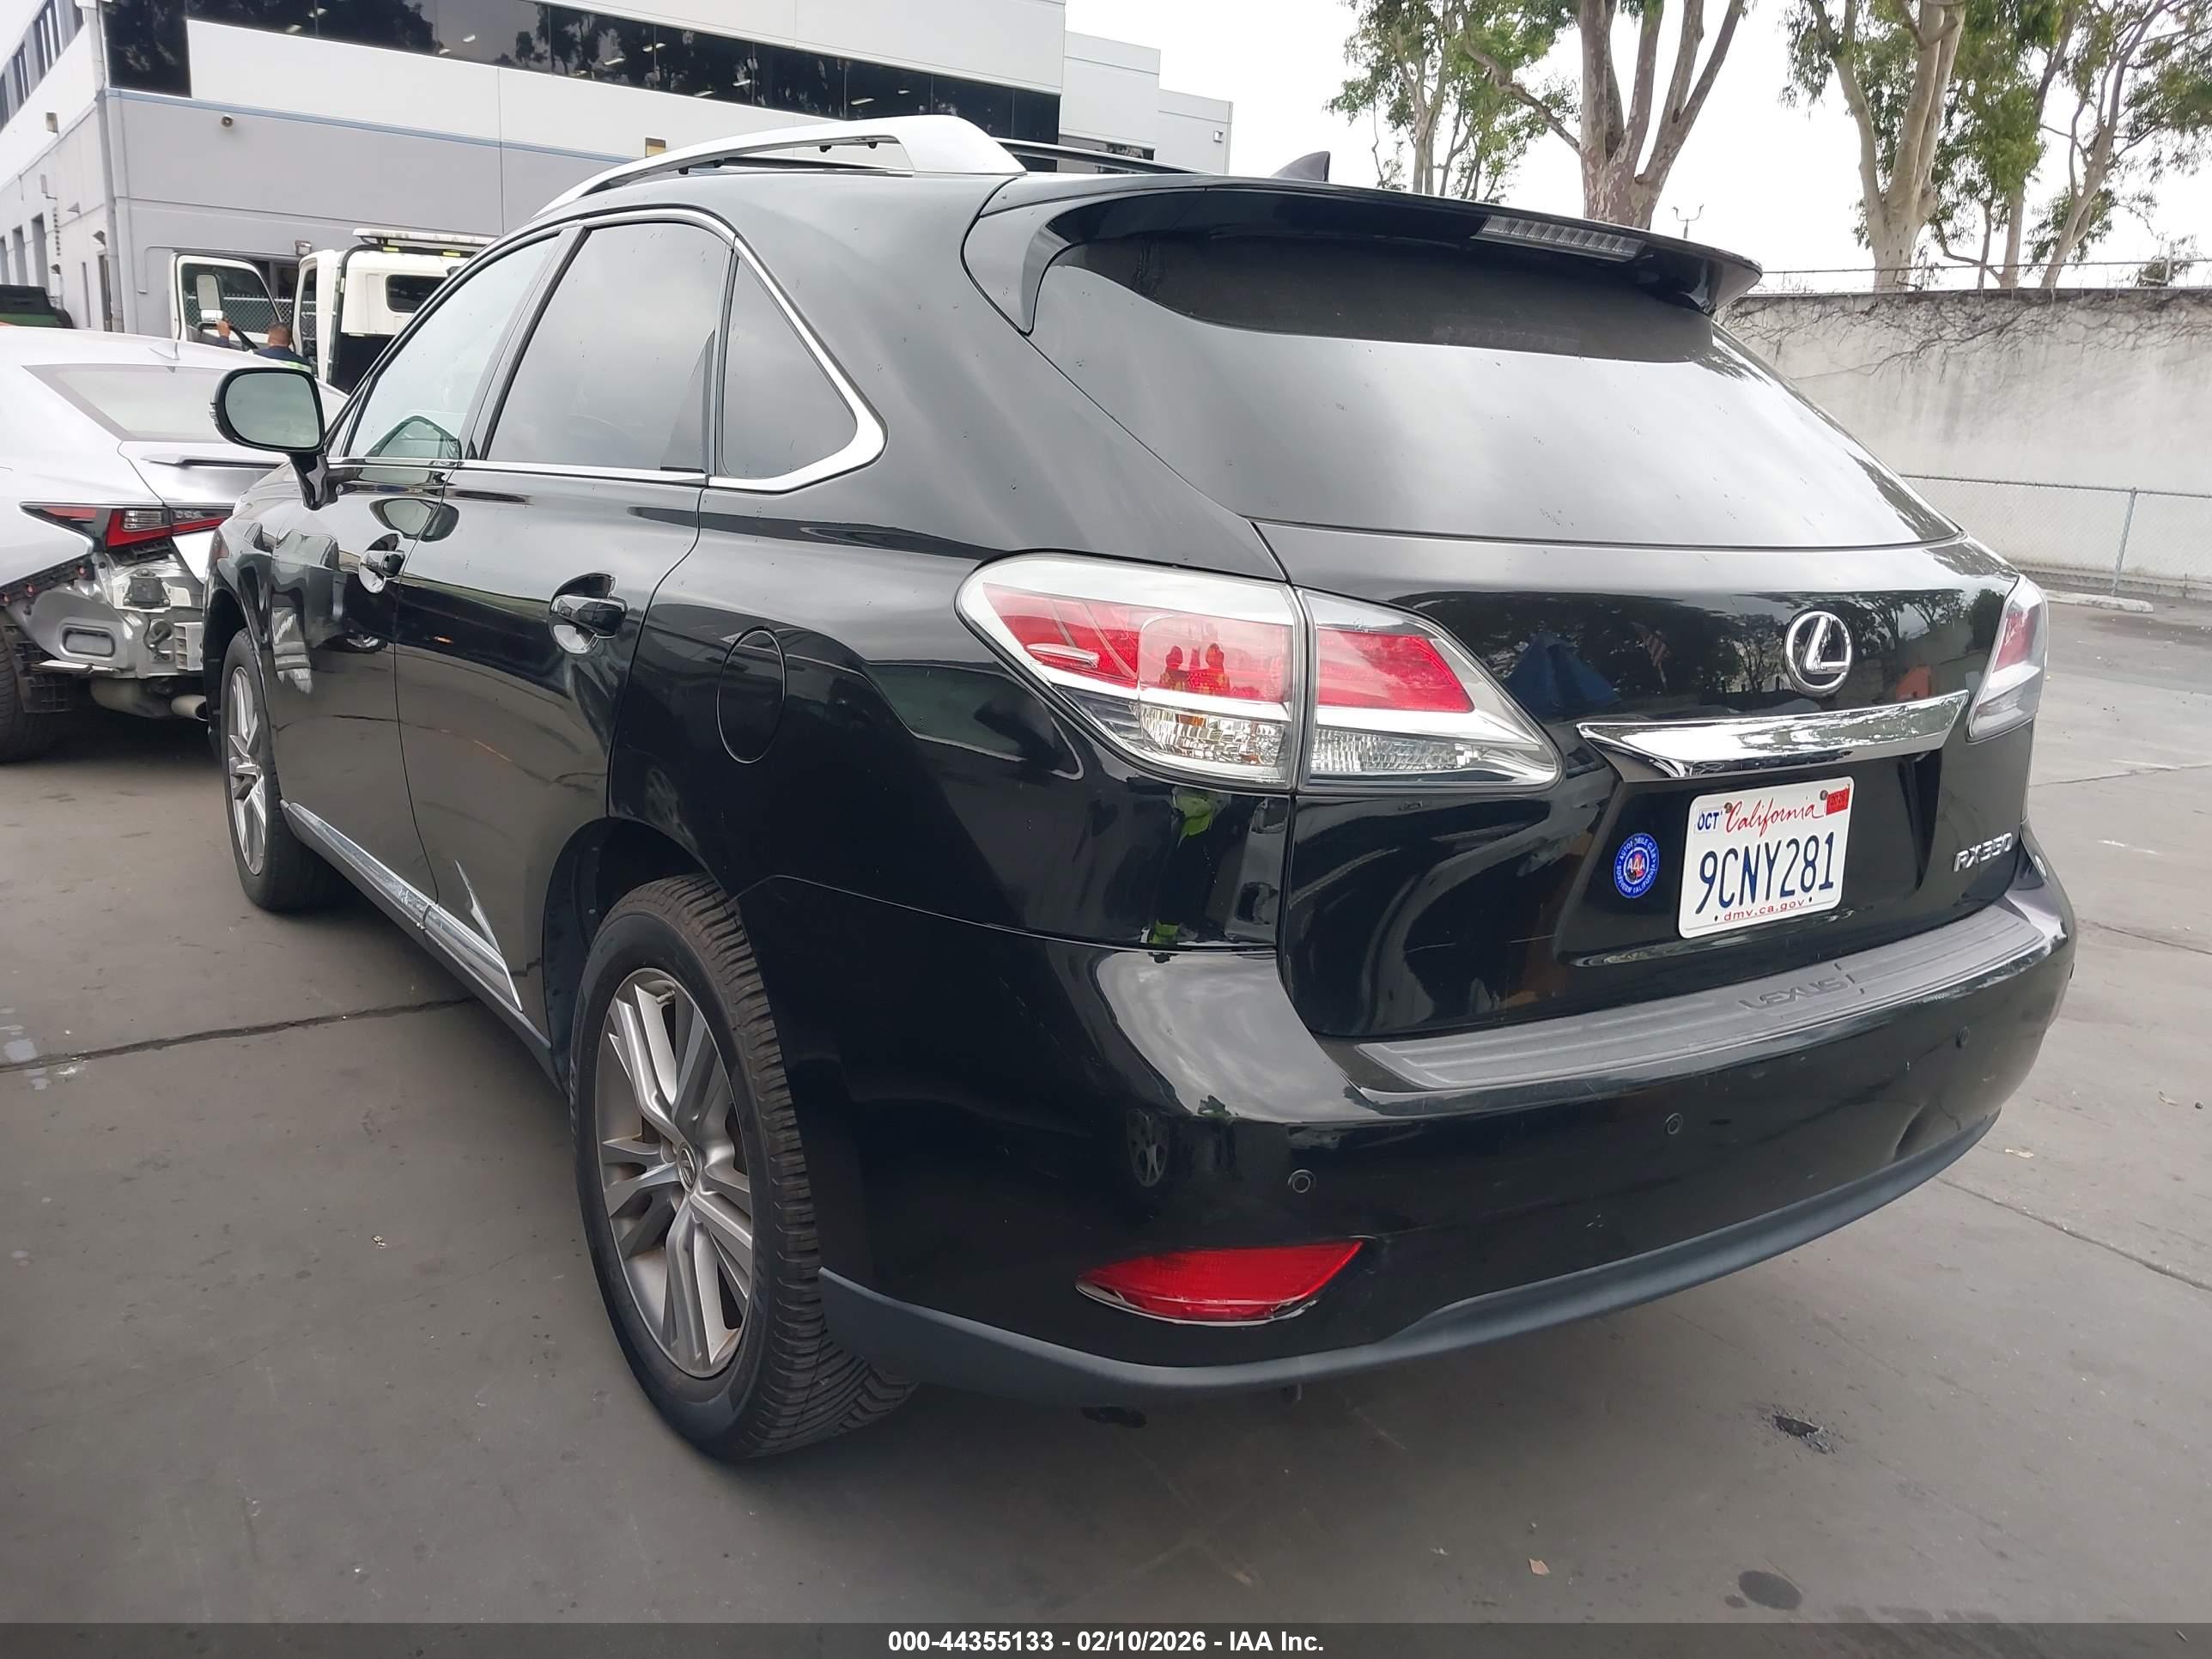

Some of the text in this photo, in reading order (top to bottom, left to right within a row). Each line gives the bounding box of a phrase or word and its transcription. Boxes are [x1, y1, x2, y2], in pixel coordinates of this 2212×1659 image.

[1697, 797, 1825, 838] OCT California
[1626, 857, 1645, 873] AAA
[1695, 831, 1834, 915] 9CNY281
[1723, 898, 1805, 921] dmv.ca.gov
[1737, 975, 1850, 1011] LEXUS
